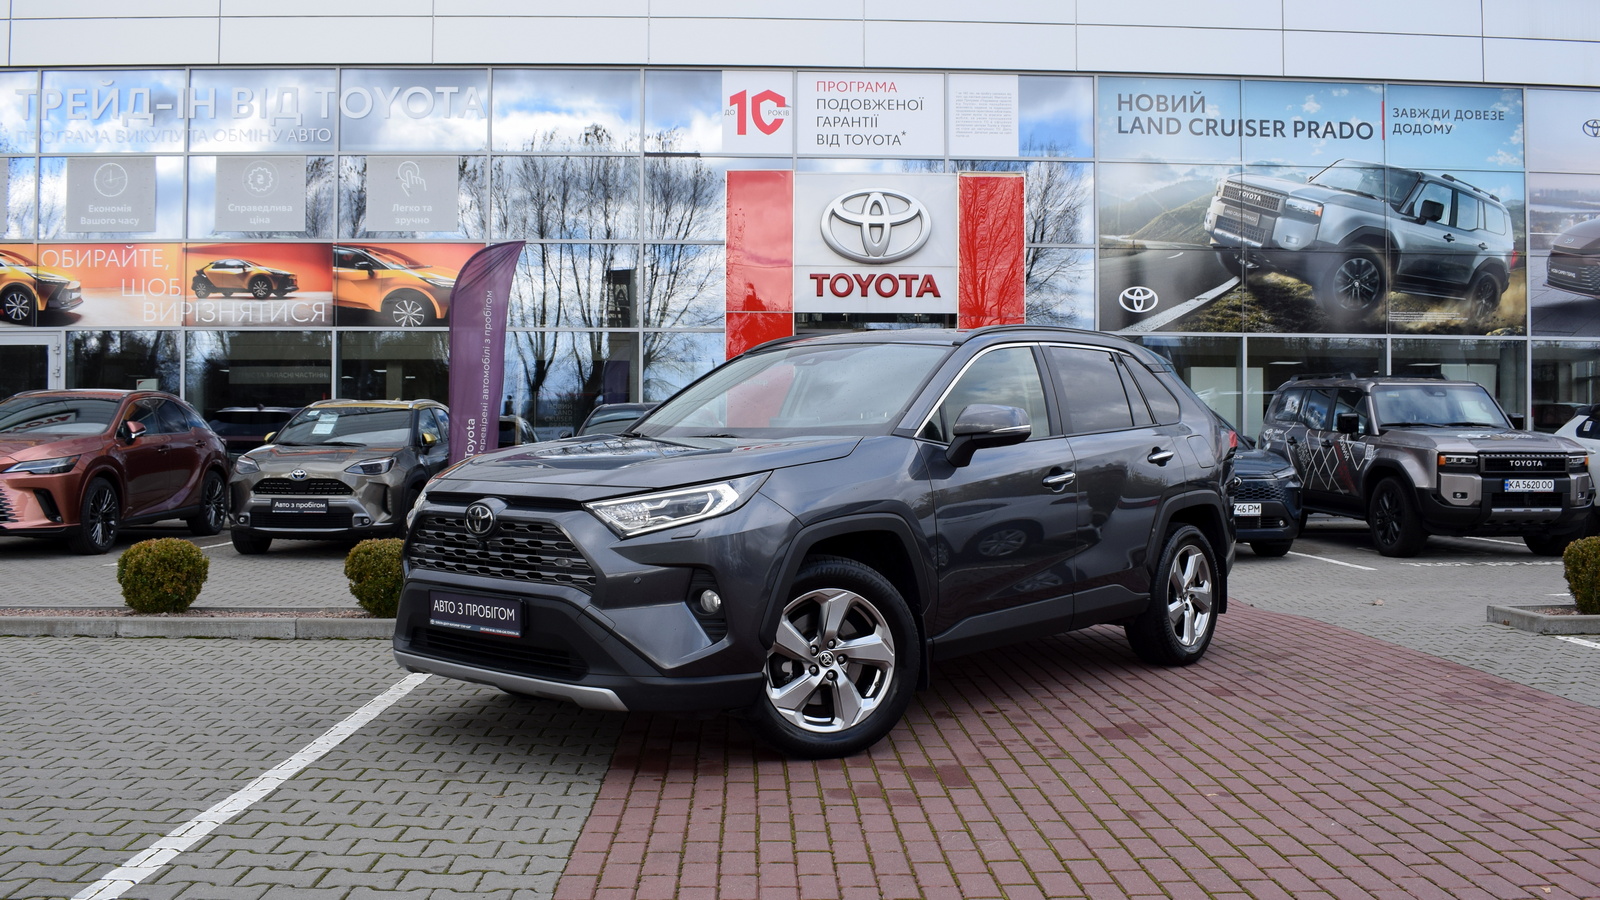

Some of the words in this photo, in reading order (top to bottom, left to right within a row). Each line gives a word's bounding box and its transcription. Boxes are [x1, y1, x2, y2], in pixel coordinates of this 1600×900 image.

[817, 81, 898, 93] ПРОГРАМА
[15, 80, 216, 127] ТРЕЙД-ІН
[231, 86, 302, 126] ВІД
[314, 86, 486, 120] TOYOTA
[817, 97, 925, 112] ПОДОВЖЕНОЇ
[1117, 91, 1206, 113] НОВИЙ
[817, 114, 879, 128] ГАРАНТІЇ
[1392, 108, 1450, 120] ЗАВЖДИ
[1454, 110, 1505, 121] ДОВЕЗЕ
[1117, 116, 1182, 135] LAND
[1188, 117, 1286, 138] CRUISER
[1293, 120, 1374, 140] PRADO
[1392, 123, 1453, 135] ДОДОМУ
[16, 129, 112, 145] ПРОГРАМА
[116, 129, 184, 144] ВИКУПУ
[212, 128, 283, 143] ОБМІНУ
[287, 127, 332, 142] АВТО
[817, 134, 840, 147] ВІД
[88, 204, 132, 213] Економія
[228, 204, 293, 213] Справедлива
[392, 204, 421, 212] Легко
[422, 204, 432, 212] та
[80, 216, 116, 225] Вашого
[118, 217, 139, 227] часу
[249, 216, 271, 225] ціна
[394, 217, 430, 227] зручно
[41, 245, 170, 270] ОБИРАЙТЕ,
[121, 278, 181, 300] ЩОБ
[810, 273, 941, 298] TOYOTA
[143, 302, 325, 323] ВИРІЗНЯТИСЯ
[483, 290, 493, 336] пробігом
[482, 346, 491, 400] автомобілі
[478, 402, 489, 454] еревірені
[464, 418, 477, 458] Toyota
[1509, 481, 1520, 489] KA
[1522, 481, 1540, 489] 5620
[295, 501, 326, 509] пробігом
[433, 600, 456, 614] АВТО
[457, 602, 463, 615] З
[465, 603, 515, 621] ПРОБІГОМ
